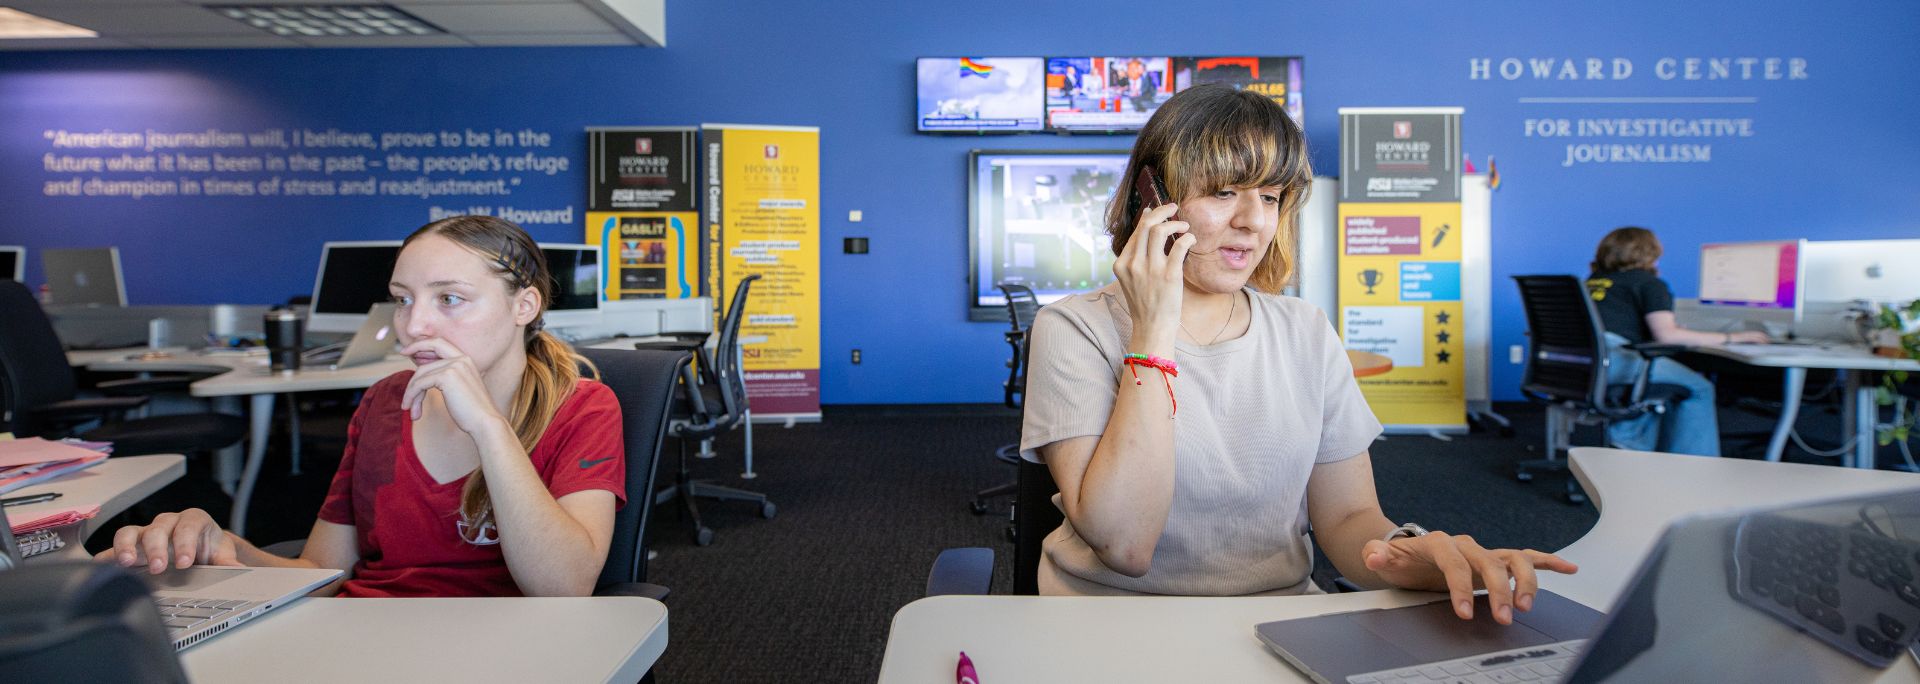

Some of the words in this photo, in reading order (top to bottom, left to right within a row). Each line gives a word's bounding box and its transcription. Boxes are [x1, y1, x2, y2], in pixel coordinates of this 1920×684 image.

[1469, 58, 1634, 80] HOWARD
[1655, 58, 1809, 80] CENTER
[1524, 119, 1571, 137] FOR
[1578, 118, 1754, 137] INVESTIGATIVE
[146, 128, 246, 152] journalism
[249, 128, 288, 149] will,
[293, 131, 300, 147] I
[304, 129, 377, 149] believe,
[381, 133, 436, 151] prove
[440, 132, 462, 148] to
[466, 129, 491, 147] be
[495, 130, 514, 147] in
[518, 129, 551, 147] the
[1376, 141, 1431, 152] HOWARD
[42, 152, 104, 171] future
[105, 153, 156, 171] what
[159, 153, 174, 171] it
[177, 153, 211, 171] has
[214, 153, 262, 171] been
[266, 153, 285, 171] in
[289, 153, 322, 171] the
[325, 155, 365, 175] past
[386, 153, 419, 171] the
[505, 152, 569, 175] refuge
[619, 156, 669, 166] HOWARD
[709, 143, 720, 185] Howard
[1562, 144, 1712, 167] JOURNALISM
[744, 164, 799, 173] HOWARD
[43, 177, 82, 195] and
[83, 177, 177, 200] champion
[180, 177, 200, 195] in
[203, 177, 256, 195] times
[258, 176, 281, 195] of
[283, 178, 335, 195] stress
[339, 176, 376, 195] and
[498, 205, 573, 224] Howard
[709, 186, 720, 223] Center
